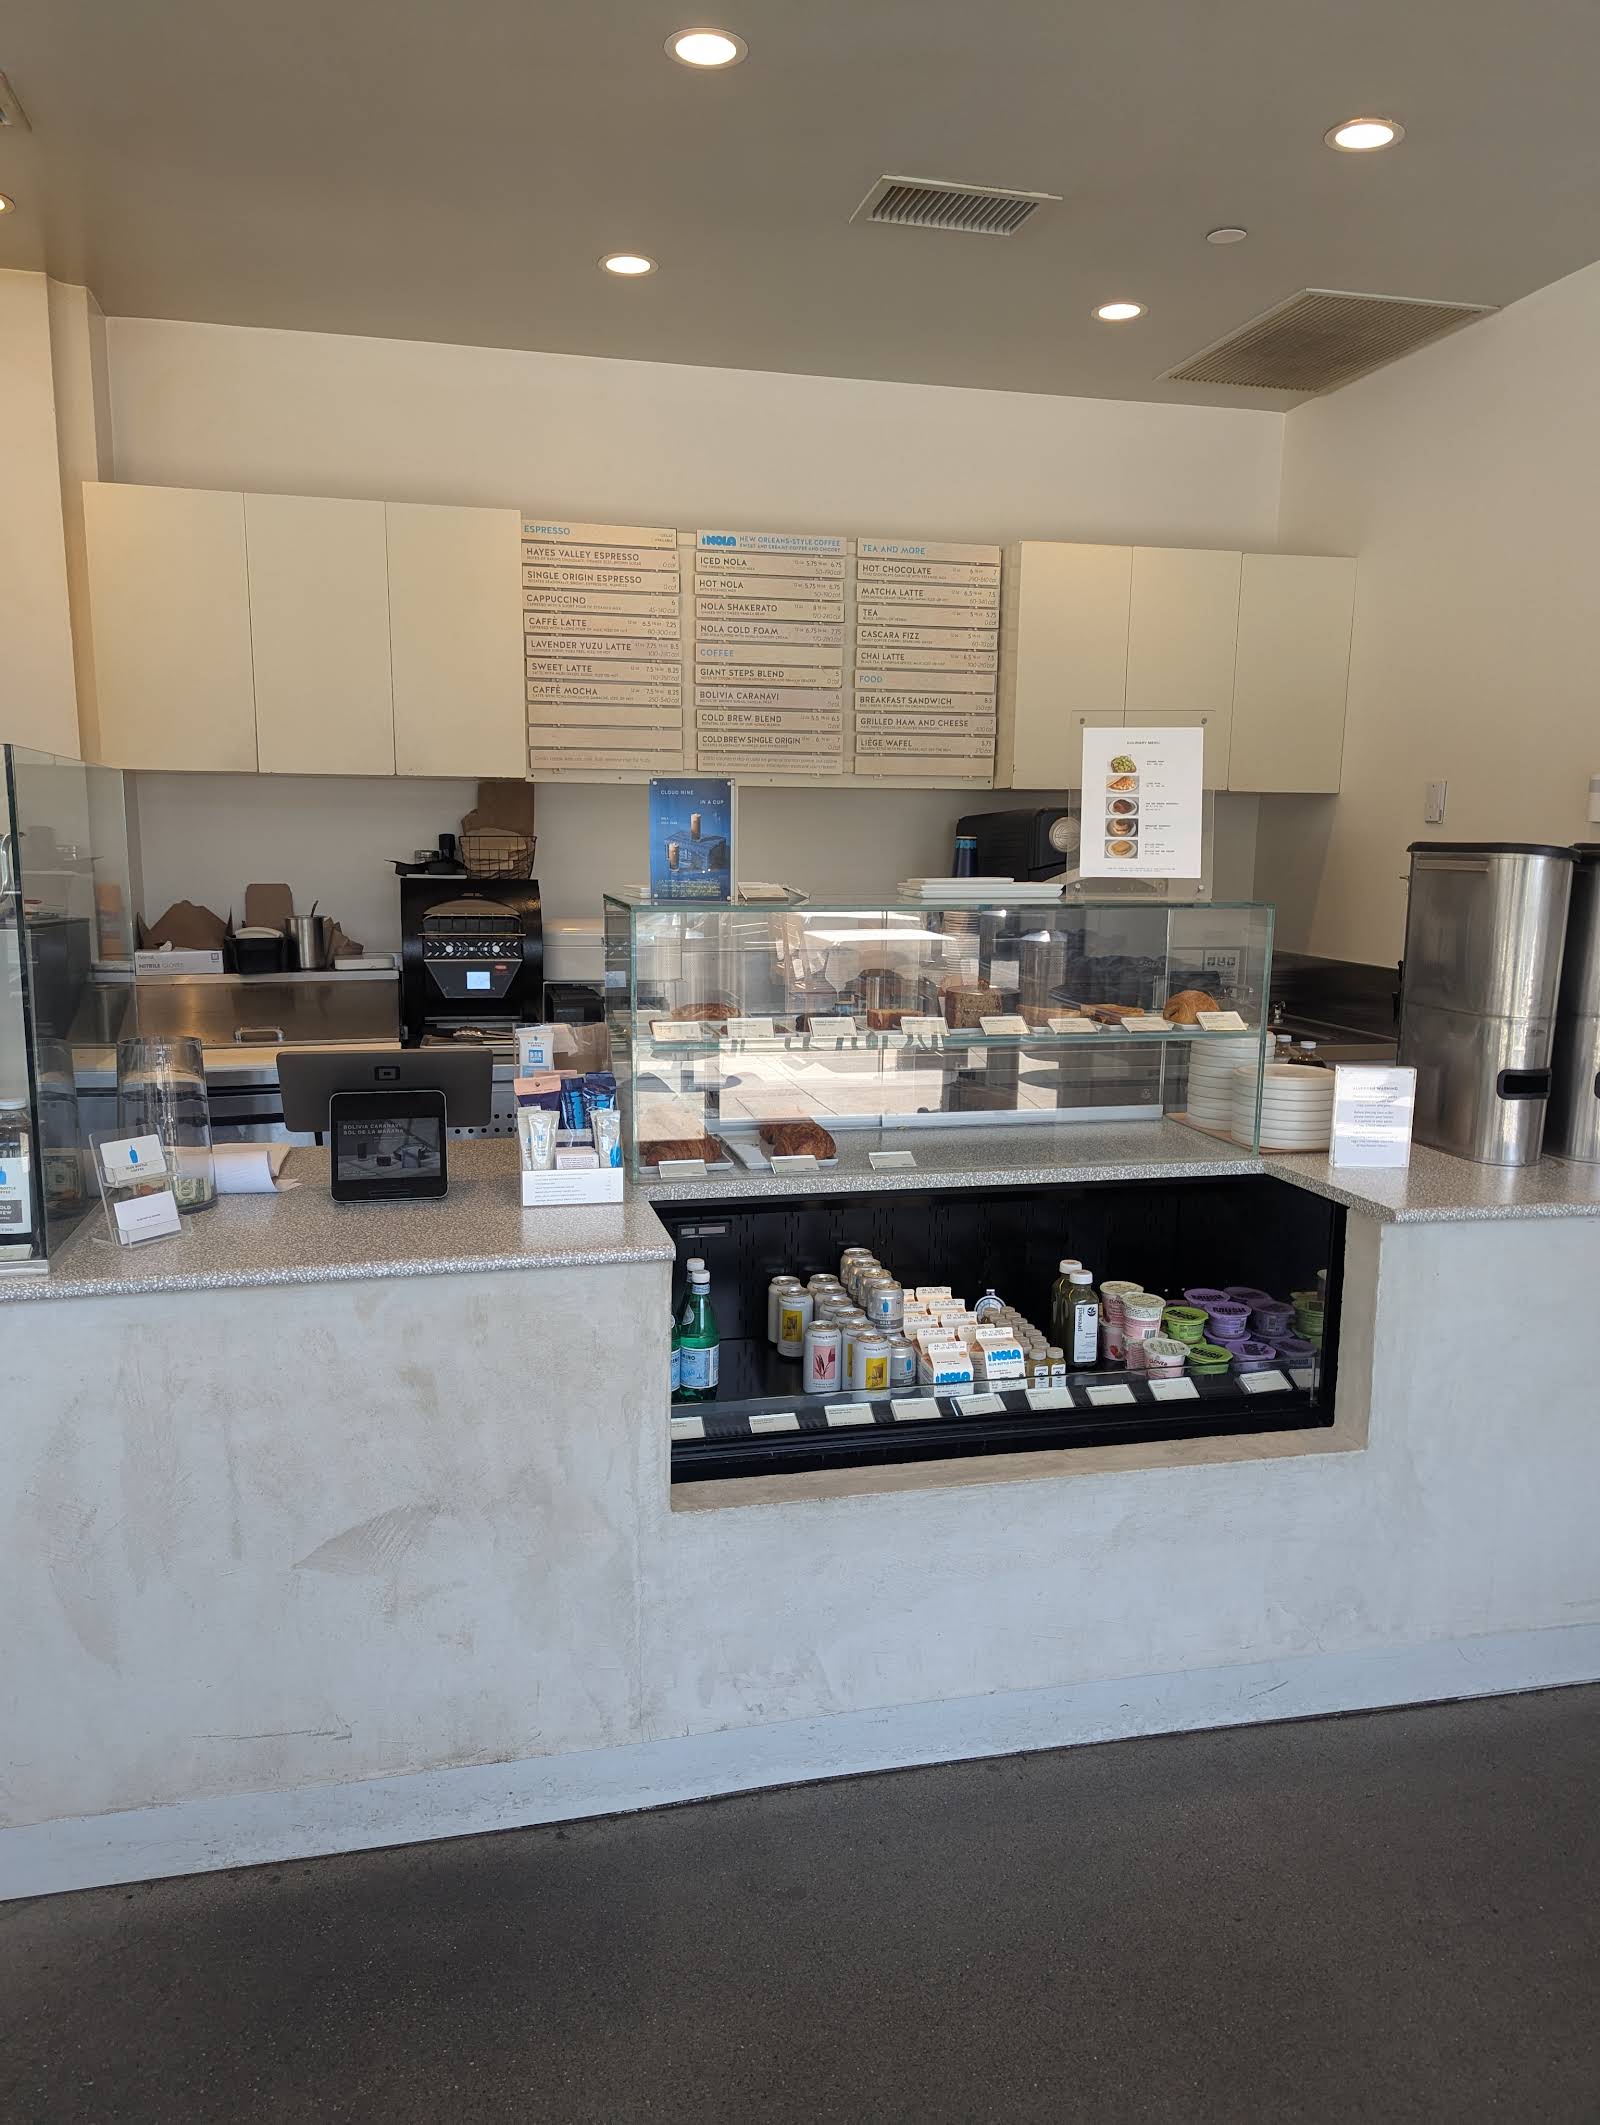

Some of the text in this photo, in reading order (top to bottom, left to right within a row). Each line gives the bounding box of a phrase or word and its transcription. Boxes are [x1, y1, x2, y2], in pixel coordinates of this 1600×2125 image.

[524, 525, 570, 535] ESPRESSO
[707, 535, 736, 546] NOLA
[863, 544, 878, 552] TEA
[881, 545, 898, 553] AND
[527, 548, 556, 556] HAYES
[559, 550, 590, 558] VALLEY
[595, 552, 639, 560] ESPRESSO
[701, 557, 720, 565] ICED
[863, 564, 879, 572] HOT
[883, 566, 931, 574] CHOCOLATE
[528, 571, 559, 579] SINGLE
[562, 573, 594, 581] ORIGIN
[597, 575, 641, 583] ESPRESSO
[721, 581, 743, 589] NOLA
[900, 589, 923, 597] LATTE
[527, 595, 586, 604] CAPPUCCINO
[728, 603, 777, 612] SHAKERATO
[700, 625, 724, 633] NOLA
[753, 627, 778, 635] FOAM
[861, 630, 899, 638] CASCARA
[531, 640, 577, 648] LAVENDER
[700, 649, 734, 657] COFFEE
[861, 652, 880, 660] CHAI
[532, 663, 562, 671] SWEET
[729, 669, 754, 677] STEPS
[700, 691, 733, 699] BOLIVIA
[737, 692, 779, 700] CARANAVI
[860, 696, 905, 704] BREAKFAST
[908, 697, 951, 705] SANDWICH
[938, 719, 968, 727] CHEESE
[886, 739, 912, 747] WAFEL
[993, 1350, 1021, 1361] NOLA
